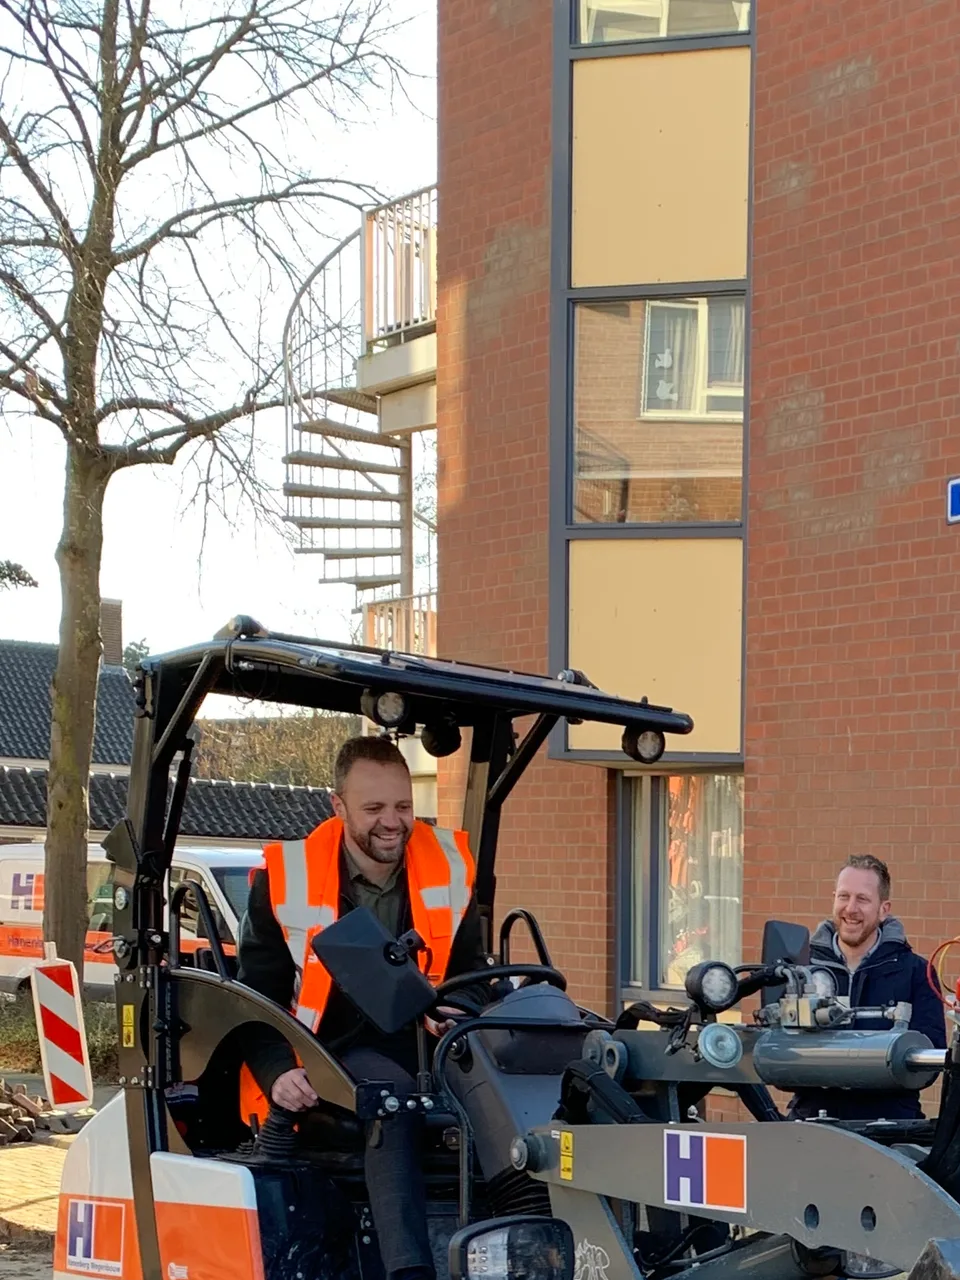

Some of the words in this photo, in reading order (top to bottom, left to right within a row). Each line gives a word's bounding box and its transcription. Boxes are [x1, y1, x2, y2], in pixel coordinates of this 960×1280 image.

[10, 873, 35, 910] H
[666, 1132, 704, 1204] H
[68, 1202, 94, 1258] H
